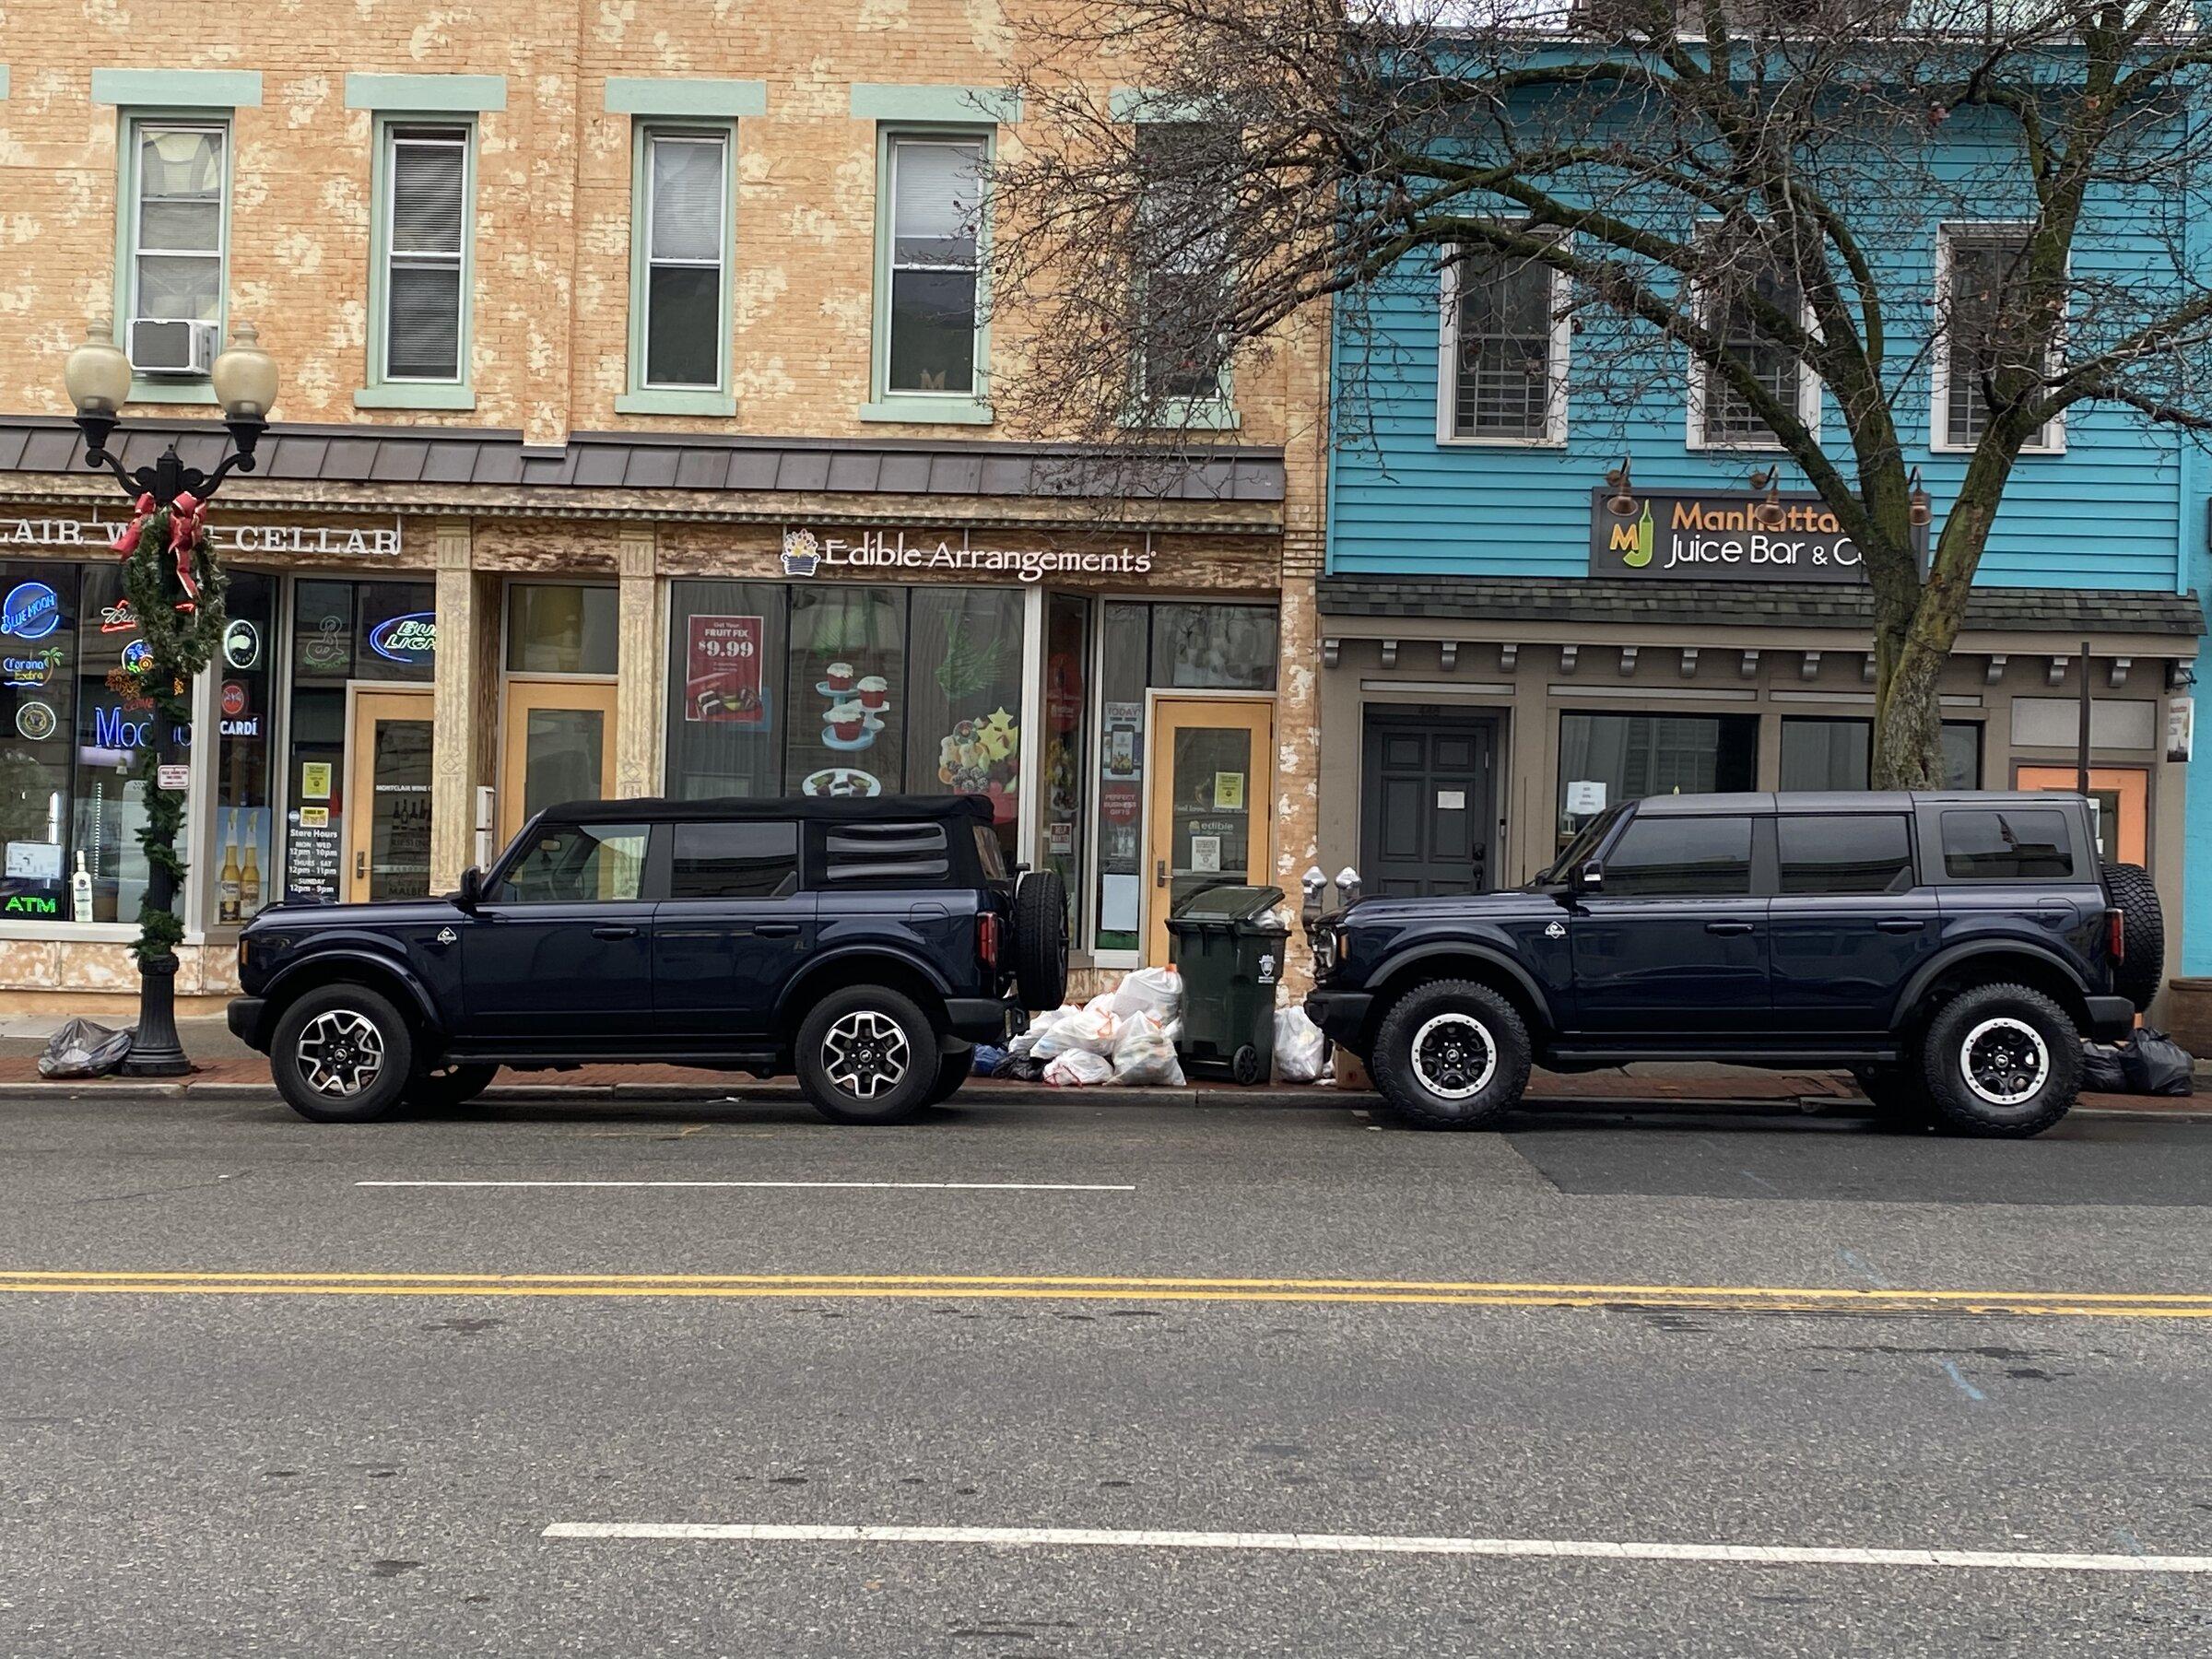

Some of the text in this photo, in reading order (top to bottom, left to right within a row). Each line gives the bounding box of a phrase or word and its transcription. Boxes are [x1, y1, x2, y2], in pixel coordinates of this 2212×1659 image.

[1671, 500, 1845, 534] Manhtta
[235, 525, 400, 556] CELLAR
[825, 532, 1152, 582] Edible Arrangements
[1663, 534, 1744, 569] Juice
[1749, 535, 1806, 565] Bar
[1811, 546, 1829, 565] &
[396, 620, 436, 637] BU
[704, 629, 748, 638] FRUIT FIX
[383, 634, 436, 651] LIG
[698, 640, 754, 658] $9.99
[3, 657, 44, 672] Corona
[219, 717, 258, 735] CARDÍ
[290, 829, 338, 839] Store Hours
[1201, 822, 1234, 831] edible
[289, 848, 311, 857] 12pm
[316, 849, 338, 858] 10pm
[288, 866, 311, 876] 12pm
[316, 867, 337, 877] 11pm
[289, 885, 311, 894] 12pm
[316, 886, 335, 894] 9pm
[388, 887, 426, 896] MALBE
[5, 896, 56, 914] ATM
